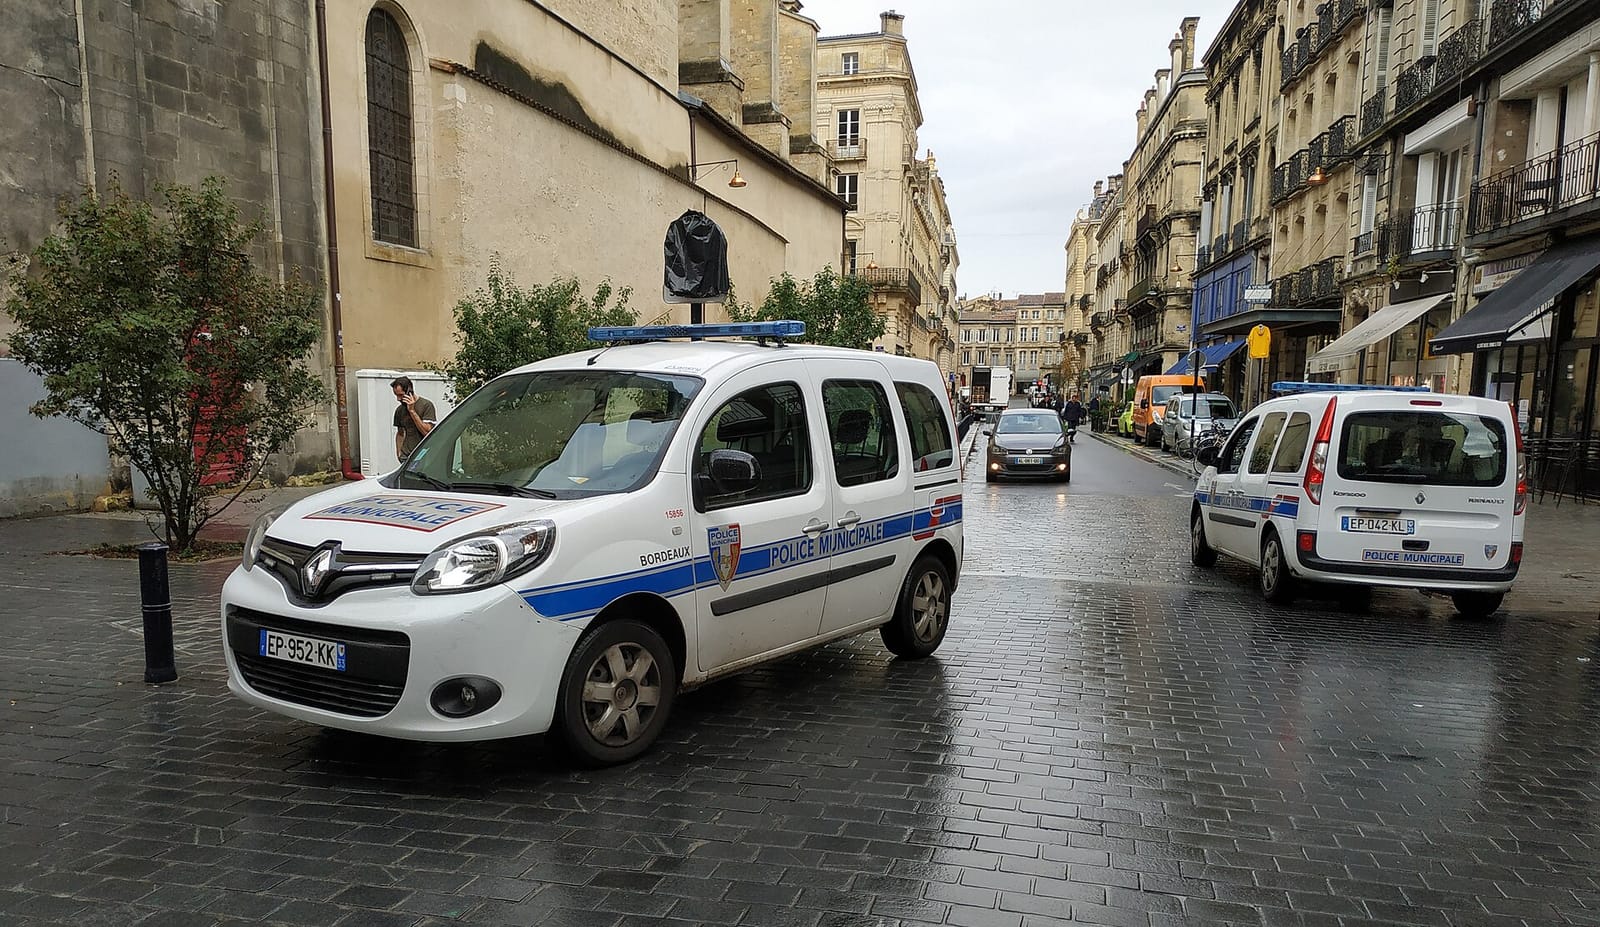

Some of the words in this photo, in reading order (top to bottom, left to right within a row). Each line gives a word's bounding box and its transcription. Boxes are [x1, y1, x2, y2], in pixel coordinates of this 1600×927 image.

[355, 495, 485, 514] POLICE
[322, 506, 454, 525] MUNICIPALE
[665, 509, 684, 519] 15856
[1350, 518, 1406, 532] EP-042-KL
[710, 529, 738, 540] POLICE
[711, 537, 738, 547] MUNICIPALE
[771, 539, 814, 566] POLICE
[819, 523, 882, 555] MUNICIPALE
[640, 546, 690, 566] BORDEAUX
[1364, 551, 1399, 561] POLICE
[1403, 553, 1462, 564] MUNICIPALE
[268, 634, 335, 667] EP-952-KK
